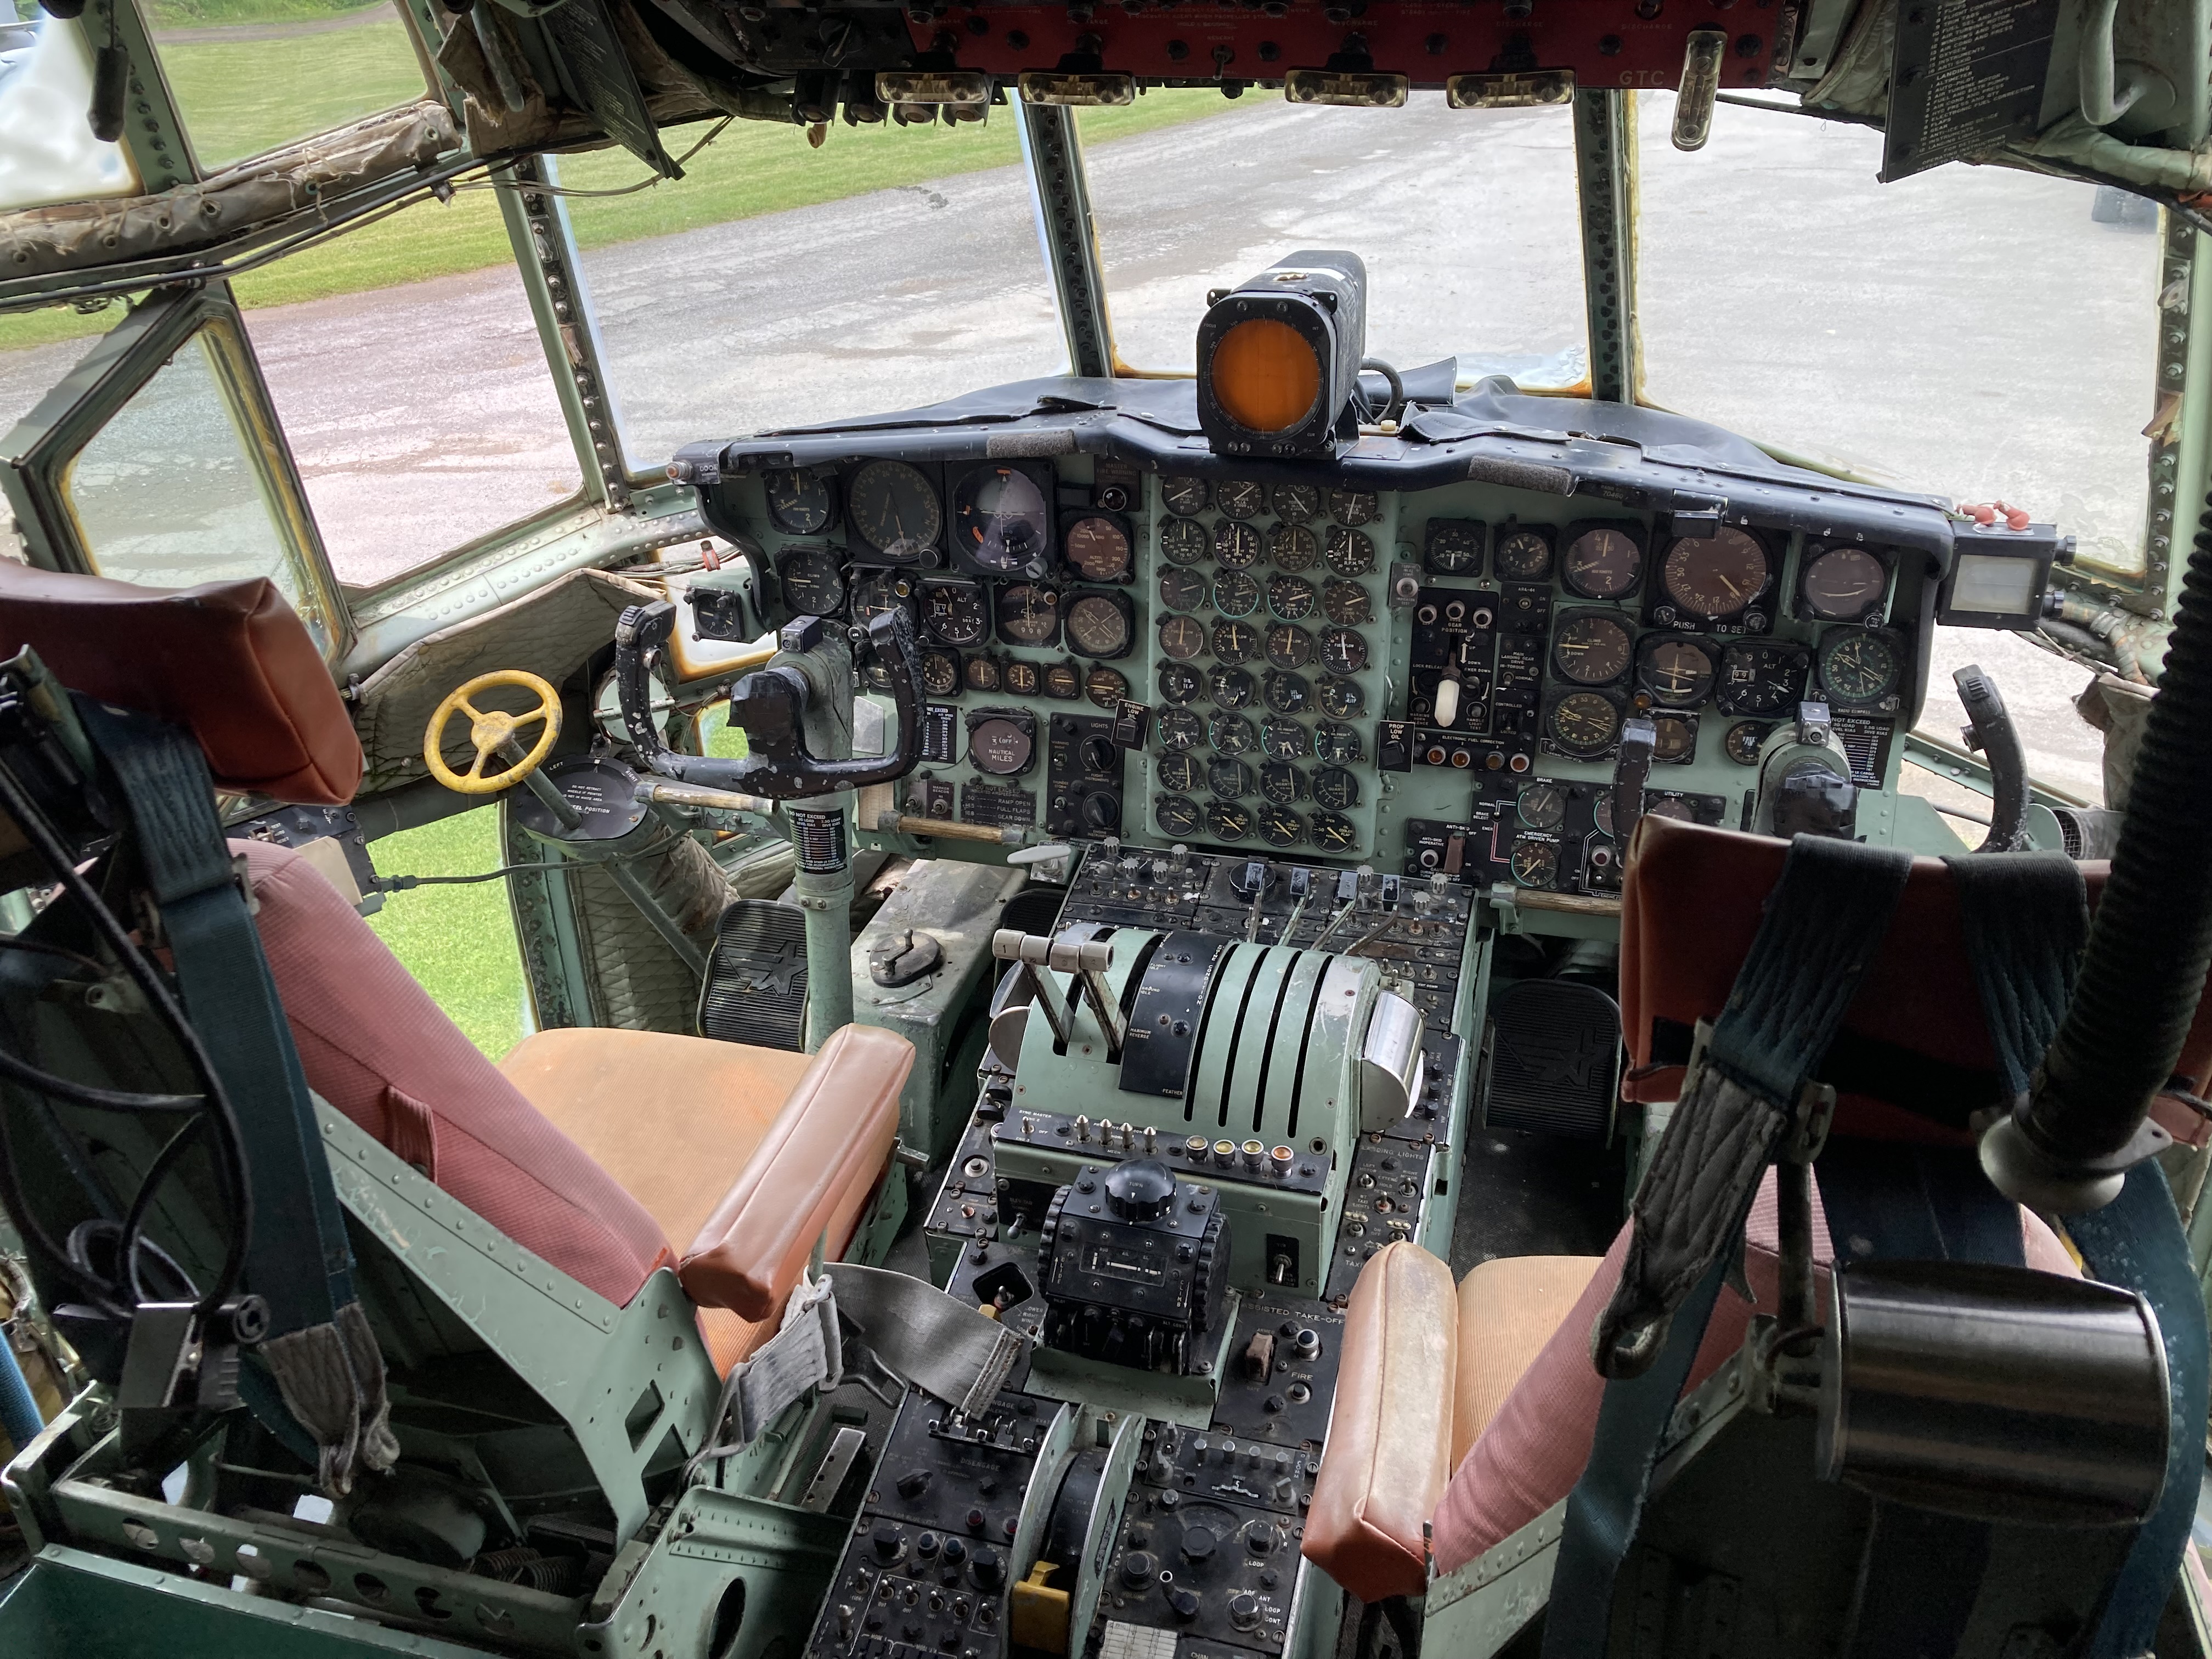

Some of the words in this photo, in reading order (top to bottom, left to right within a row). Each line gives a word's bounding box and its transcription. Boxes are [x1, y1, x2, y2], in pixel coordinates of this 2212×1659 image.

[1620, 70, 1664, 85] GTC
[1936, 71, 1973, 86] ALTIMETER
[1937, 65, 1971, 81] LANDING
[1935, 76, 1975, 92] AUTO-PILOT
[1931, 105, 1972, 122] ELECTRONIC
[1993, 84, 2035, 101] CORRECTION
[1930, 124, 1948, 133] GEAR
[1931, 117, 1952, 128] FLAPS
[1928, 126, 1974, 144] INSTRUMENTS
[1922, 150, 1958, 165] OPERATING
[1959, 134, 2006, 153] INSTRUCTIONS
[1603, 490, 1624, 499] 70460
[1673, 620, 1696, 630] PUSH
[1716, 624, 1727, 633] TO
[1124, 702, 1144, 712] ENGINE
[989, 748, 1015, 757] NAUTICAL
[991, 754, 1013, 763] MILES
[549, 761, 564, 771] LEFT
[625, 770, 638, 783] RIGHT
[1002, 944, 1007, 953] 1
[1197, 964, 1213, 1005] CONDITION
[1362, 1146, 1394, 1155] LANDING
[1398, 1152, 1424, 1160] LIGHTS
[1057, 1256, 1065, 1284] GLIDE
[1345, 1260, 1363, 1268] TAXI
[1242, 1302, 1290, 1316] ASSISTED
[1295, 1311, 1345, 1325] TAKE-OFF
[1291, 1372, 1314, 1381] FIRE
[960, 1457, 1001, 1472] DISENGAGE
[1294, 1460, 1302, 1480] COMM
[1248, 1560, 1265, 1568] LOOP
